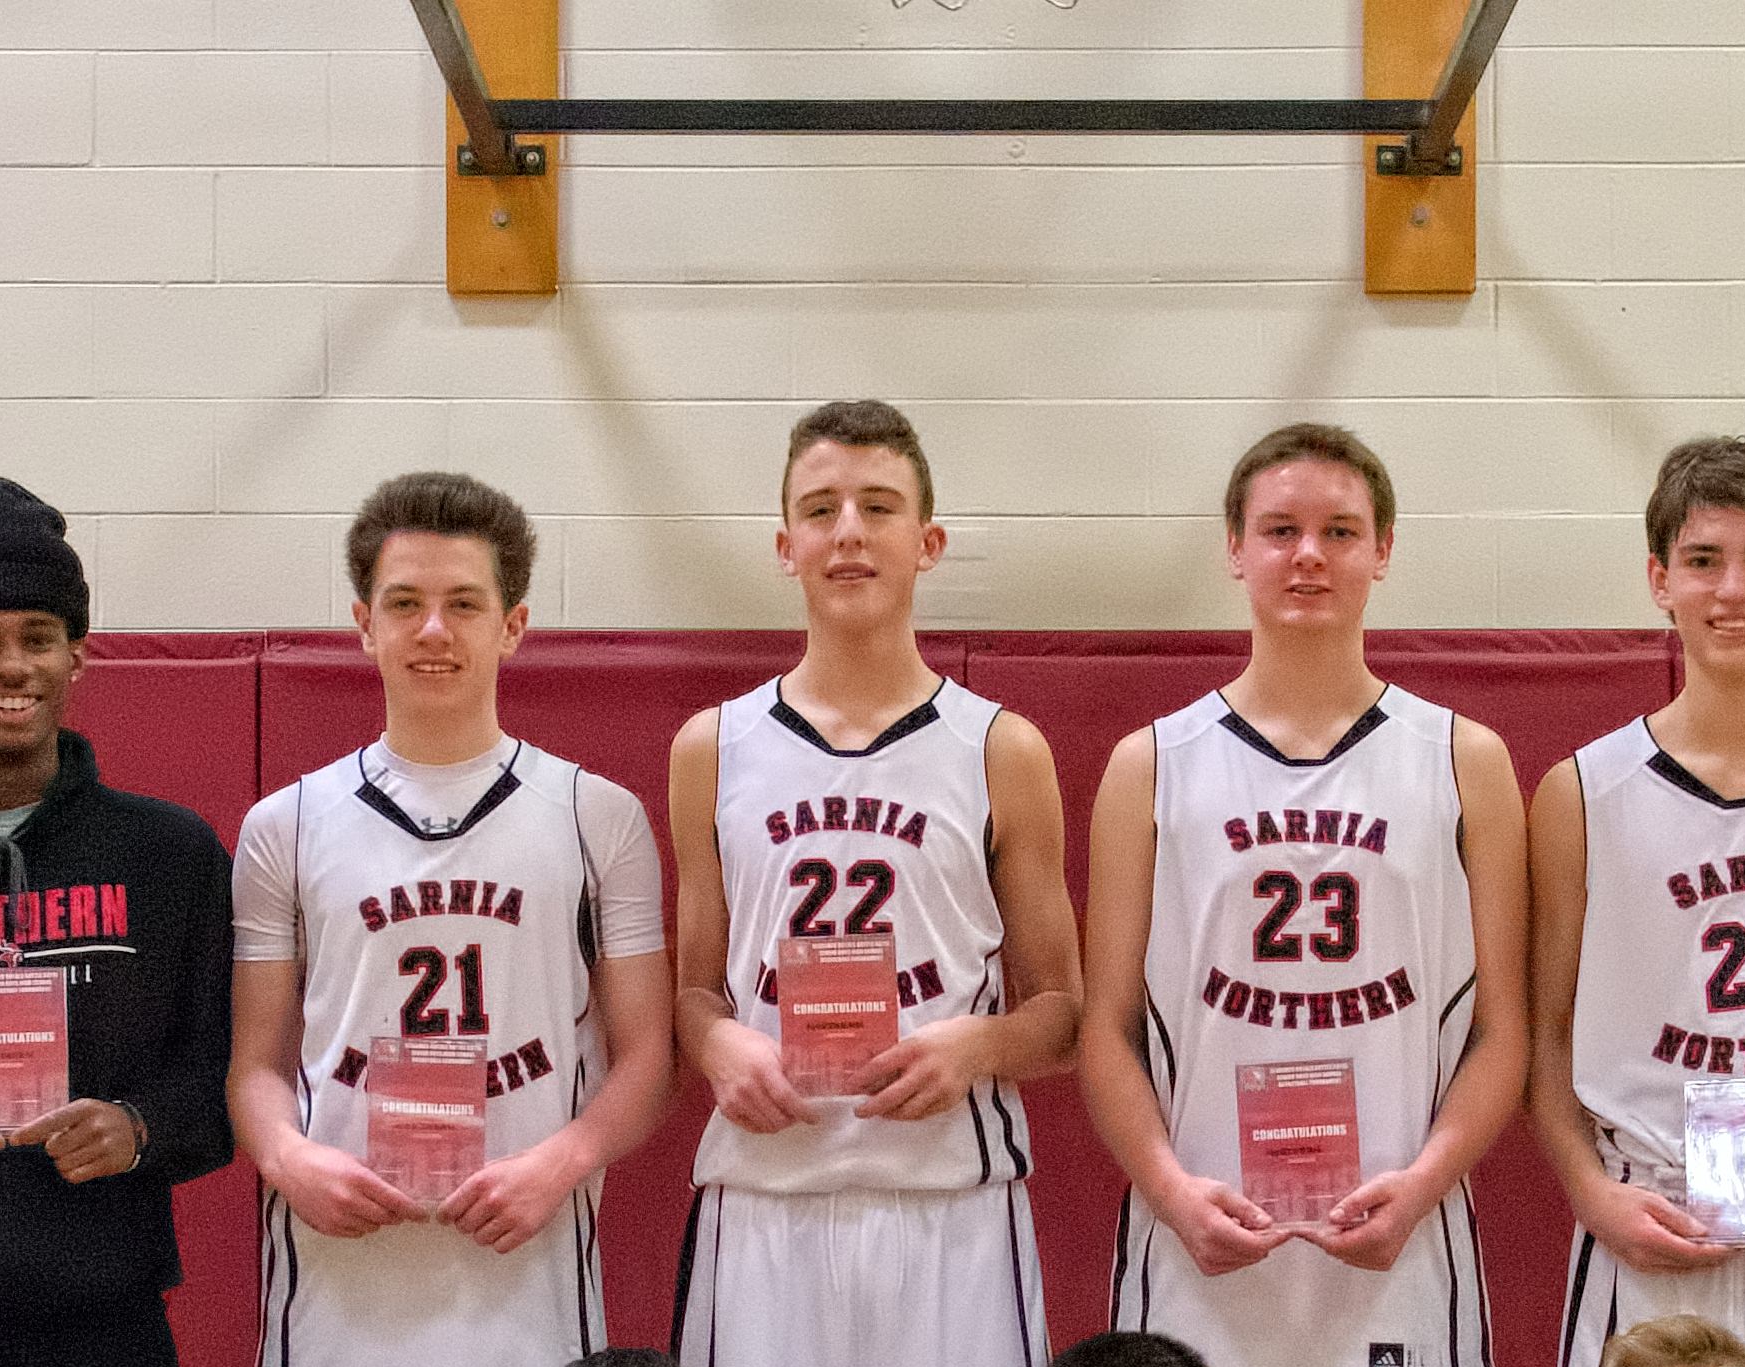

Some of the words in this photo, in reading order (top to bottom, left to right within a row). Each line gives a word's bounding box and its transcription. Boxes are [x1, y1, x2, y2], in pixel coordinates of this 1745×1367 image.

[765, 796, 928, 849] SARNIA
[1224, 809, 1389, 855] SARNIA
[358, 880, 524, 933] SARNIA
[789, 858, 896, 937] 22
[1252, 870, 1360, 962] 23
[398, 944, 489, 1037] 21
[793, 1001, 886, 1015] CONGRATULATIONS
[1203, 966, 1416, 1030] NORTHERN
[1252, 1124, 1347, 1142] CONGRATULATIONS
